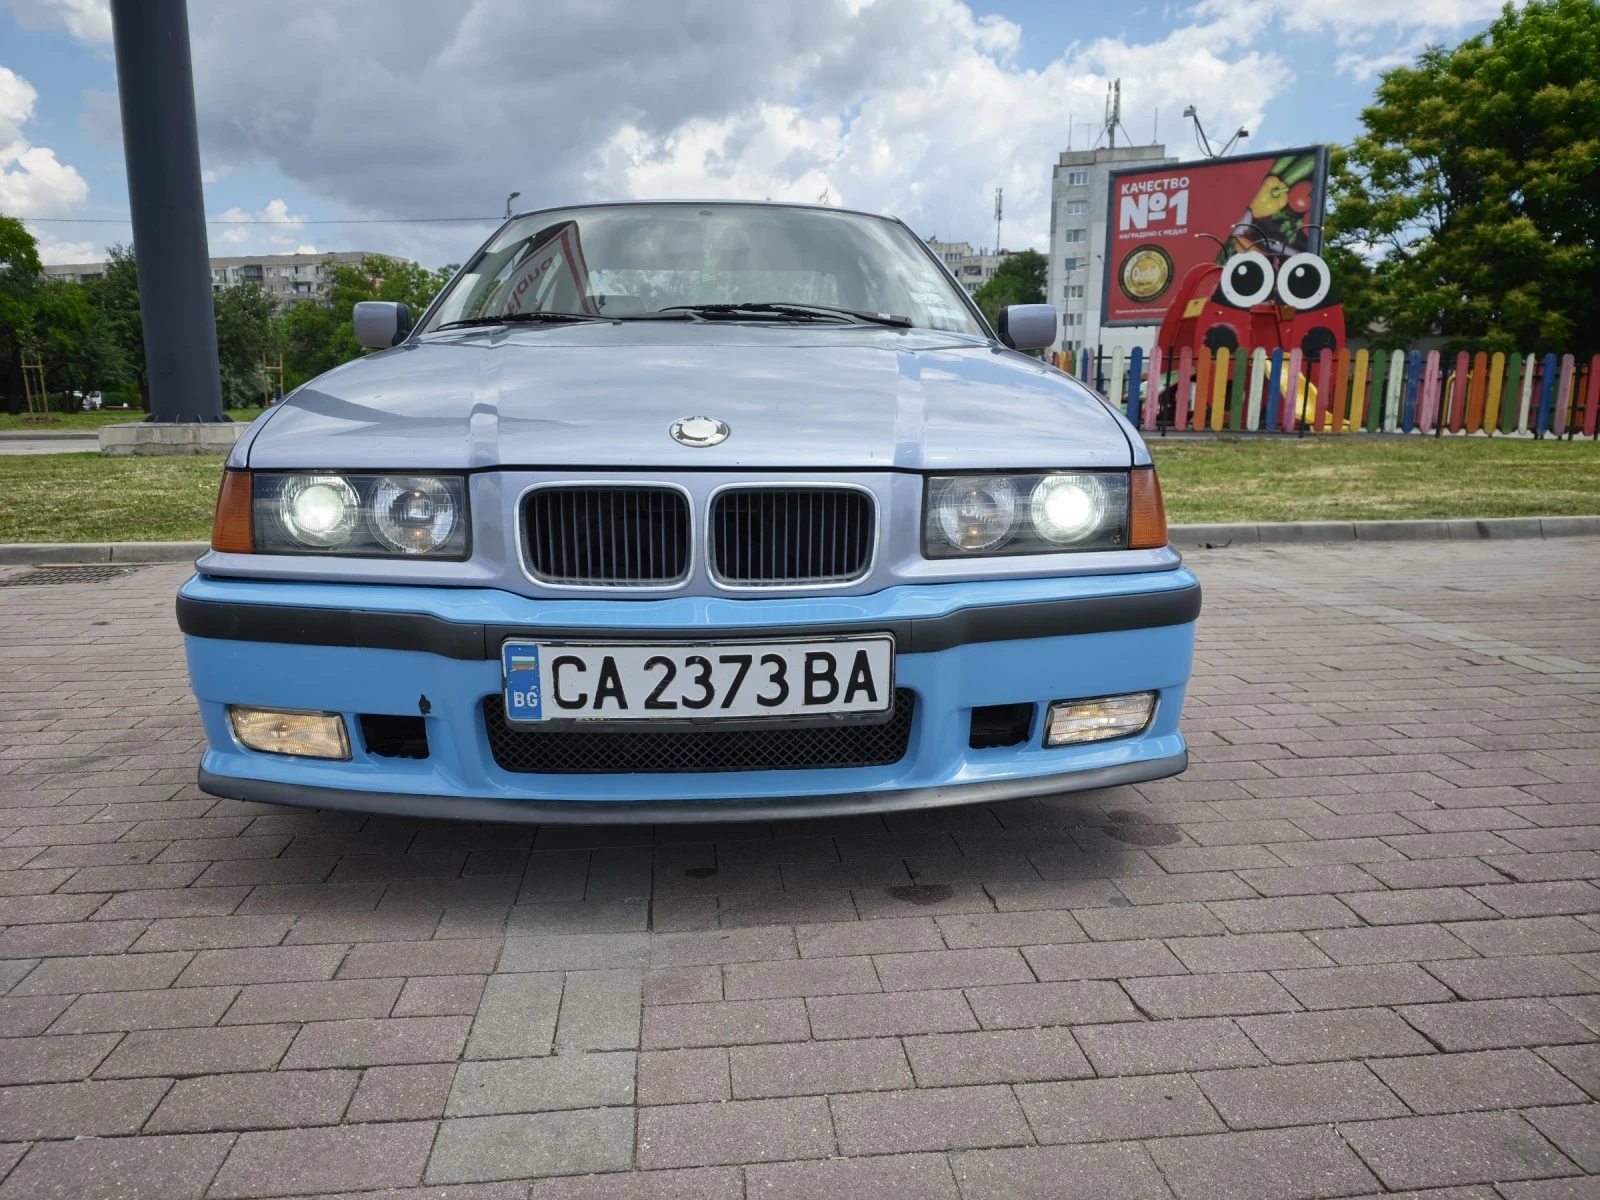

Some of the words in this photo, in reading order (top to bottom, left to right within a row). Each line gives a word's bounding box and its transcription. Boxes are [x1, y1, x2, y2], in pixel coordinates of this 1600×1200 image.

[1121, 177, 1190, 195] КАЧЕСТВО
[1119, 230, 1157, 240] НАГРАДЕНО
[1163, 228, 1188, 236] МЕДАЛ
[551, 655, 629, 710] CA
[643, 653, 790, 710] 2373
[804, 650, 877, 705] BA
[513, 690, 538, 708] BG
